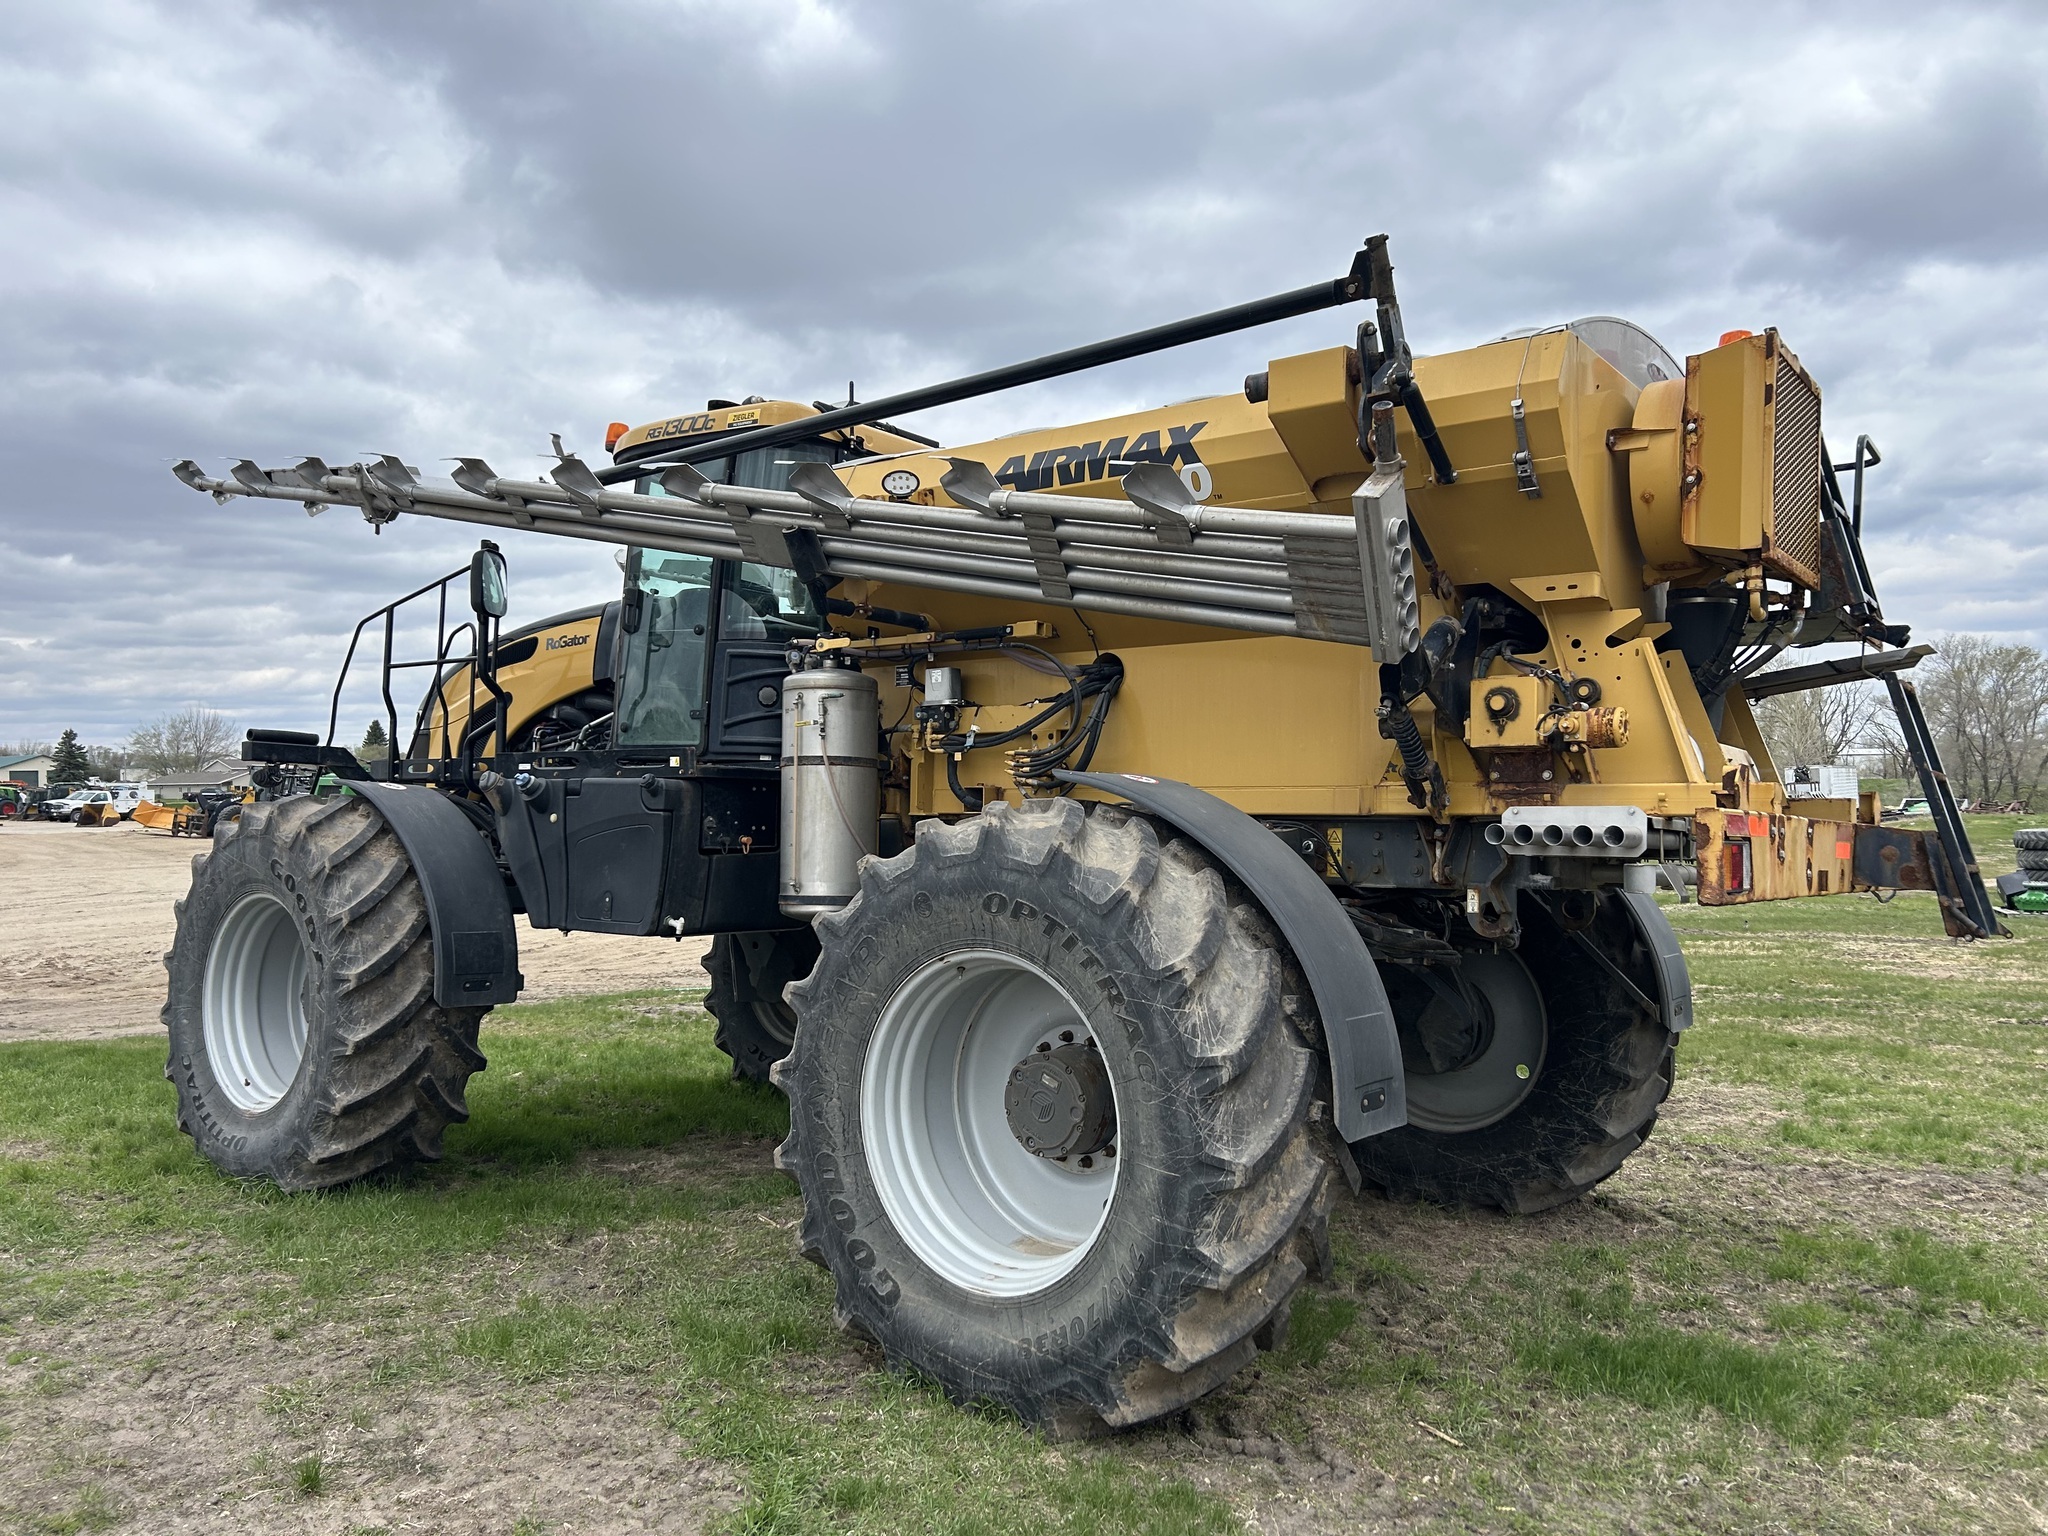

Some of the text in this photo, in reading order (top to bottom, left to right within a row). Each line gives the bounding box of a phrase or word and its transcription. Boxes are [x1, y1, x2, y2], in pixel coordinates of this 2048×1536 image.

[732, 411, 755, 422] ZIEGLER
[994, 421, 1208, 493] AIRMAX
[546, 634, 591, 651] RoGator
[982, 891, 1158, 1085] OPTITRAC
[181, 1054, 249, 1153] OPTITRAC
